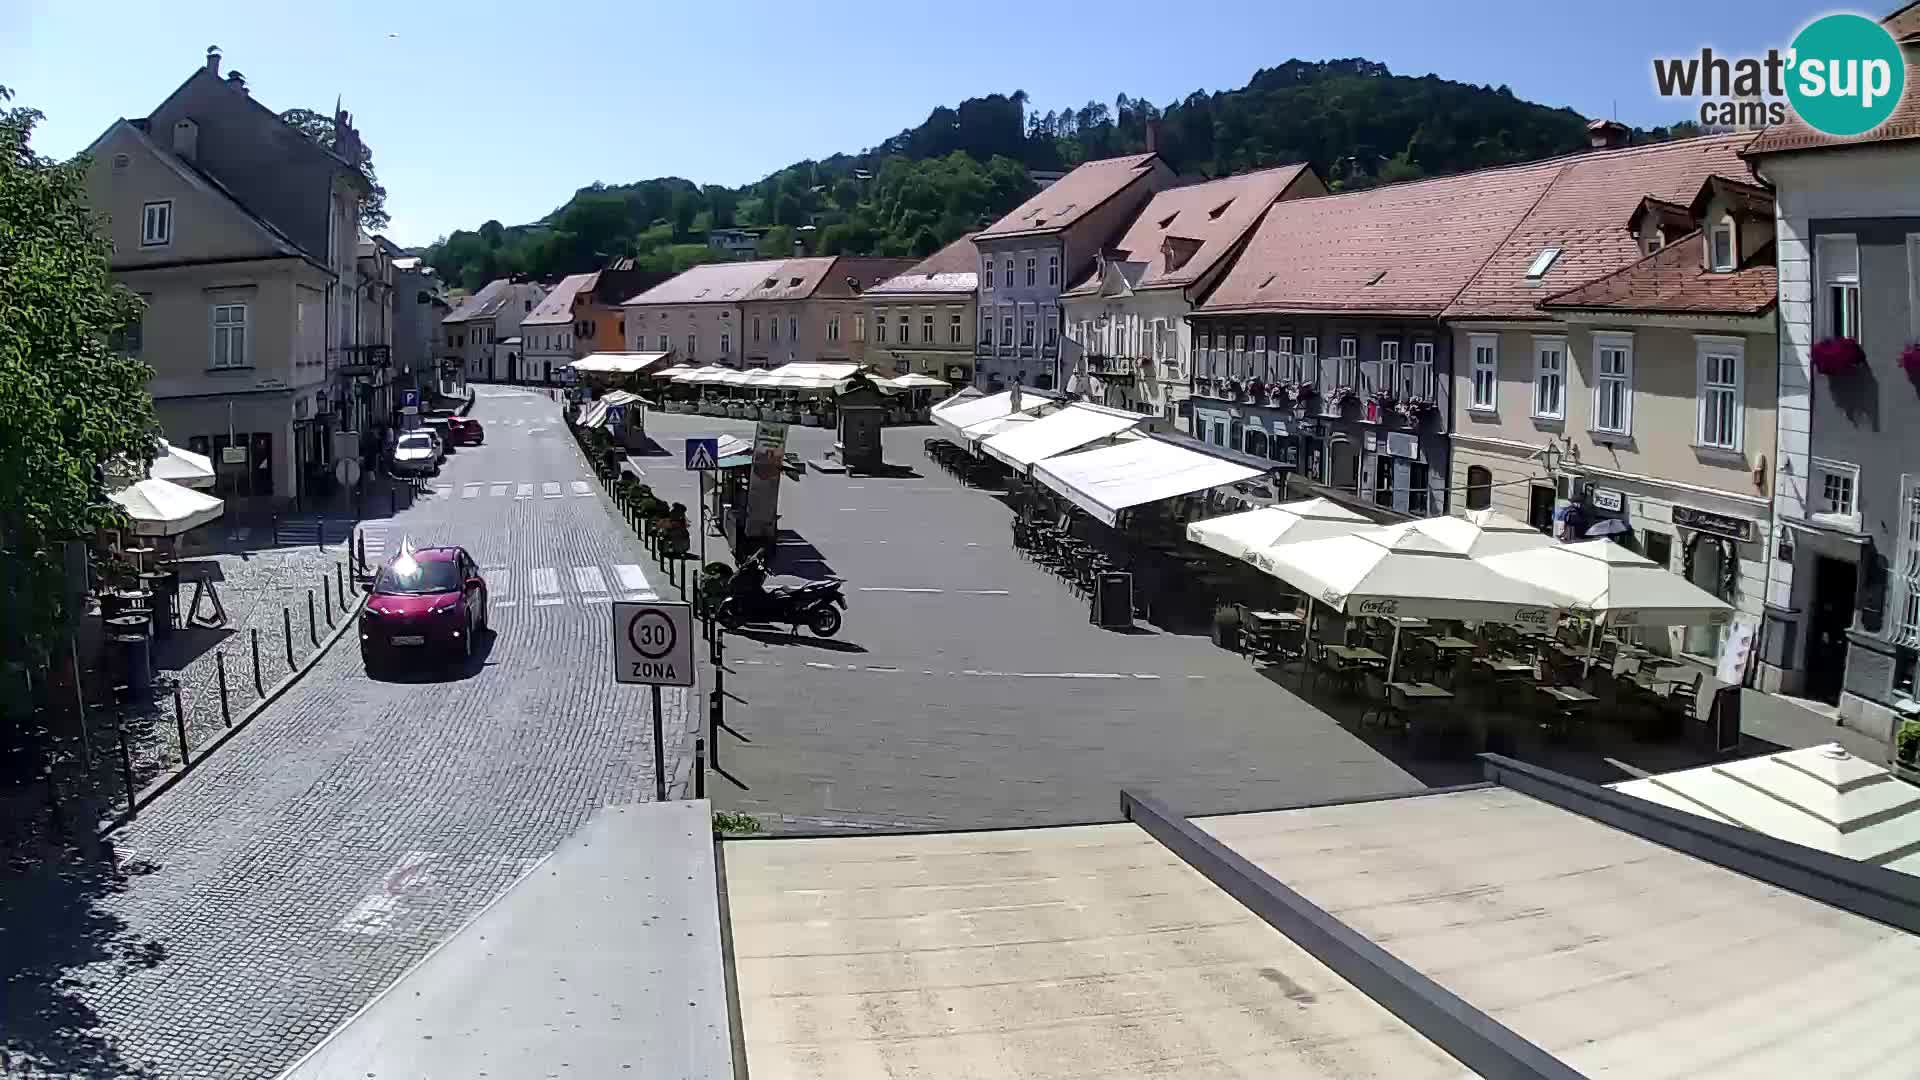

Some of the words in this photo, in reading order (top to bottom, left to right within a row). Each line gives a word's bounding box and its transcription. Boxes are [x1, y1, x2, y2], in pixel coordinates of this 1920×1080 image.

[406, 392, 415, 406] P
[641, 625, 665, 645] 30
[632, 662, 676, 679] ZONA
